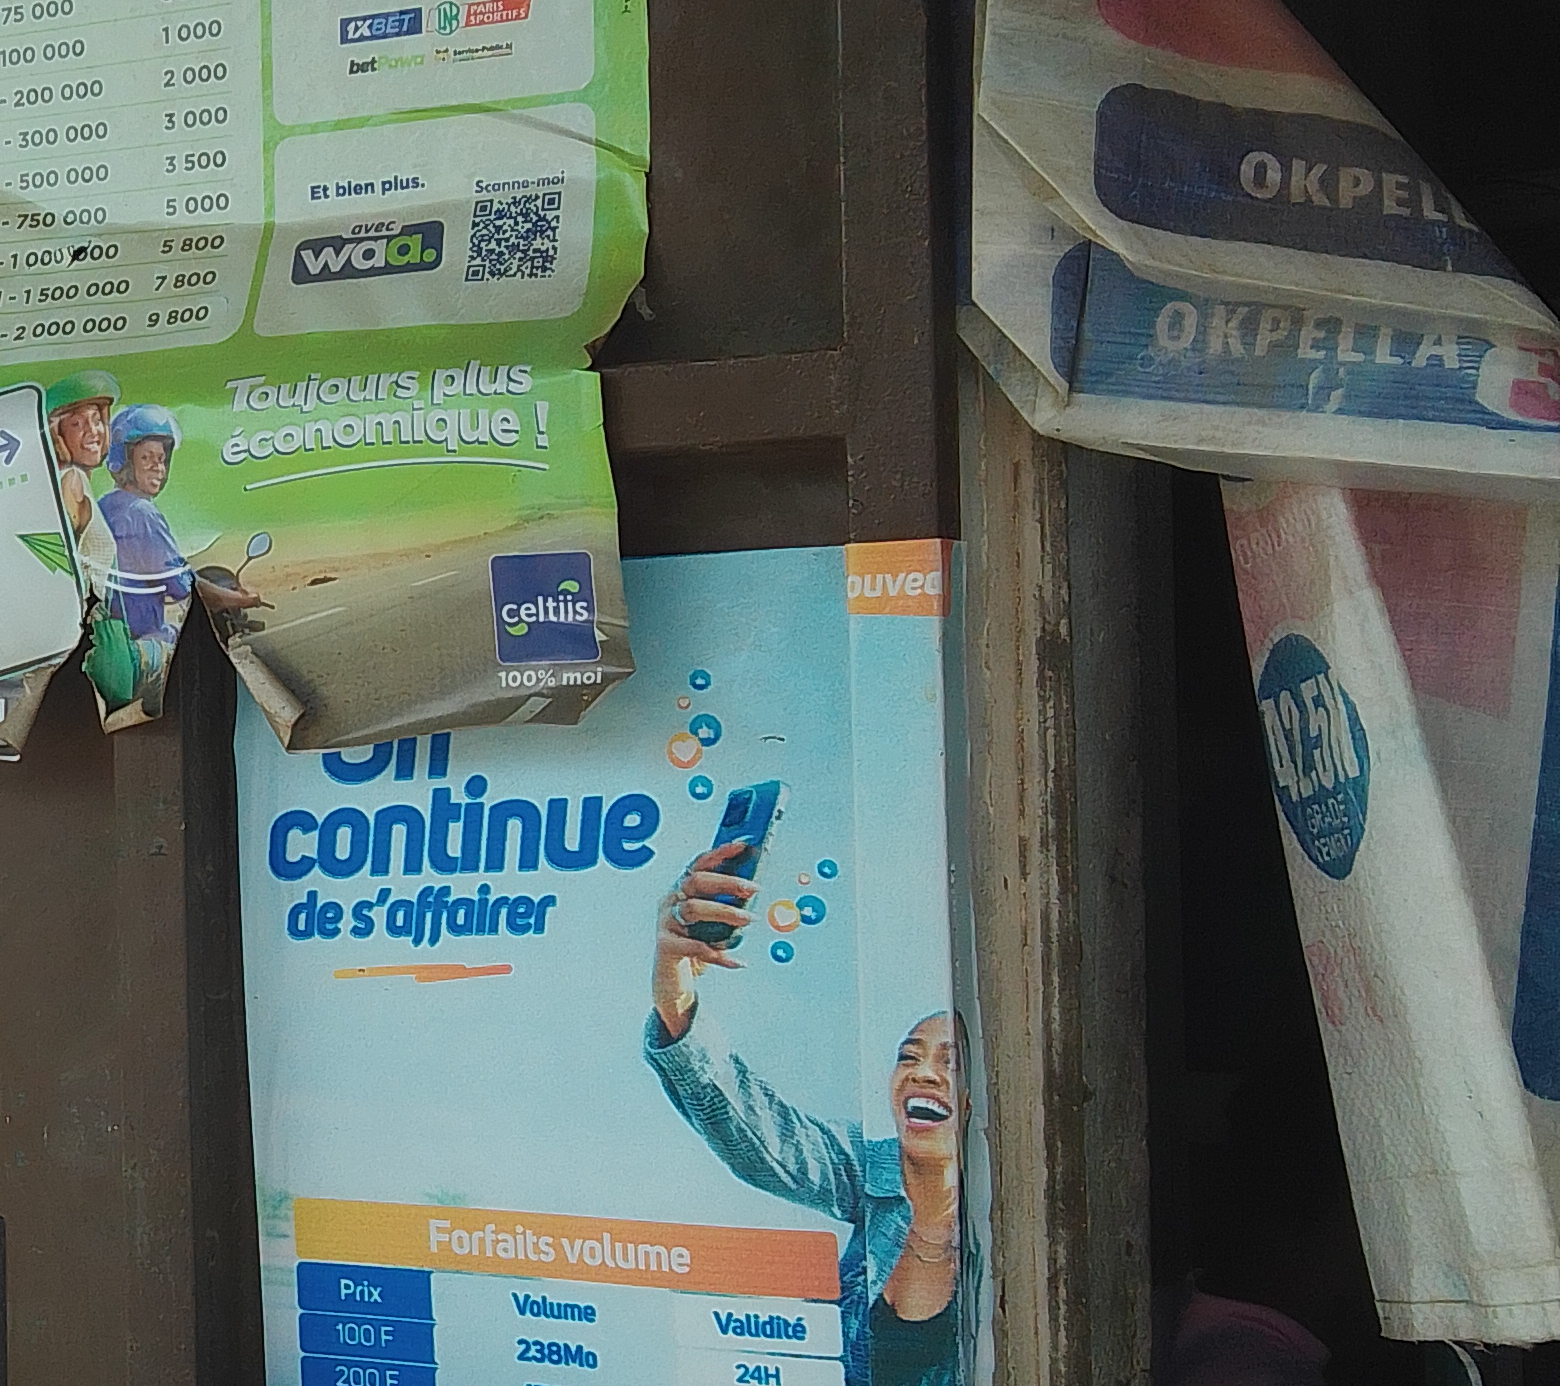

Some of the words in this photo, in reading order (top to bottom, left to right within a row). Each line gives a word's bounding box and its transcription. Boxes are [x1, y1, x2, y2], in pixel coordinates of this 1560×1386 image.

[345, 12, 416, 40] 1XBET
[469, 8, 526, 25] SPORTIFS
[470, 1, 503, 14] PARIS
[309, 184, 330, 201] Et
[335, 180, 376, 199] bien
[381, 175, 426, 195] plus.
[474, 170, 566, 193] Scanne-moi
[351, 219, 397, 236] avec
[1155, 300, 1464, 369] OKPELLA
[225, 369, 421, 413] Toujours
[432, 359, 533, 405] plus
[221, 399, 522, 465] économique
[501, 594, 589, 624] celtiis
[497, 667, 556, 688] 100%
[561, 666, 603, 685] moi
[268, 774, 661, 881] continue
[286, 889, 344, 941] de
[349, 882, 558, 948] s'affairer
[427, 1218, 556, 1263] Forfaits
[562, 1232, 692, 1274] volume
[339, 1279, 383, 1303] Prix
[512, 1292, 597, 1324] Volume
[712, 1310, 808, 1341] Validité
[335, 1323, 376, 1348] 100
[380, 1327, 394, 1349] F
[515, 1338, 598, 1369] 238Mo
[734, 1362, 782, 1386] 24H
